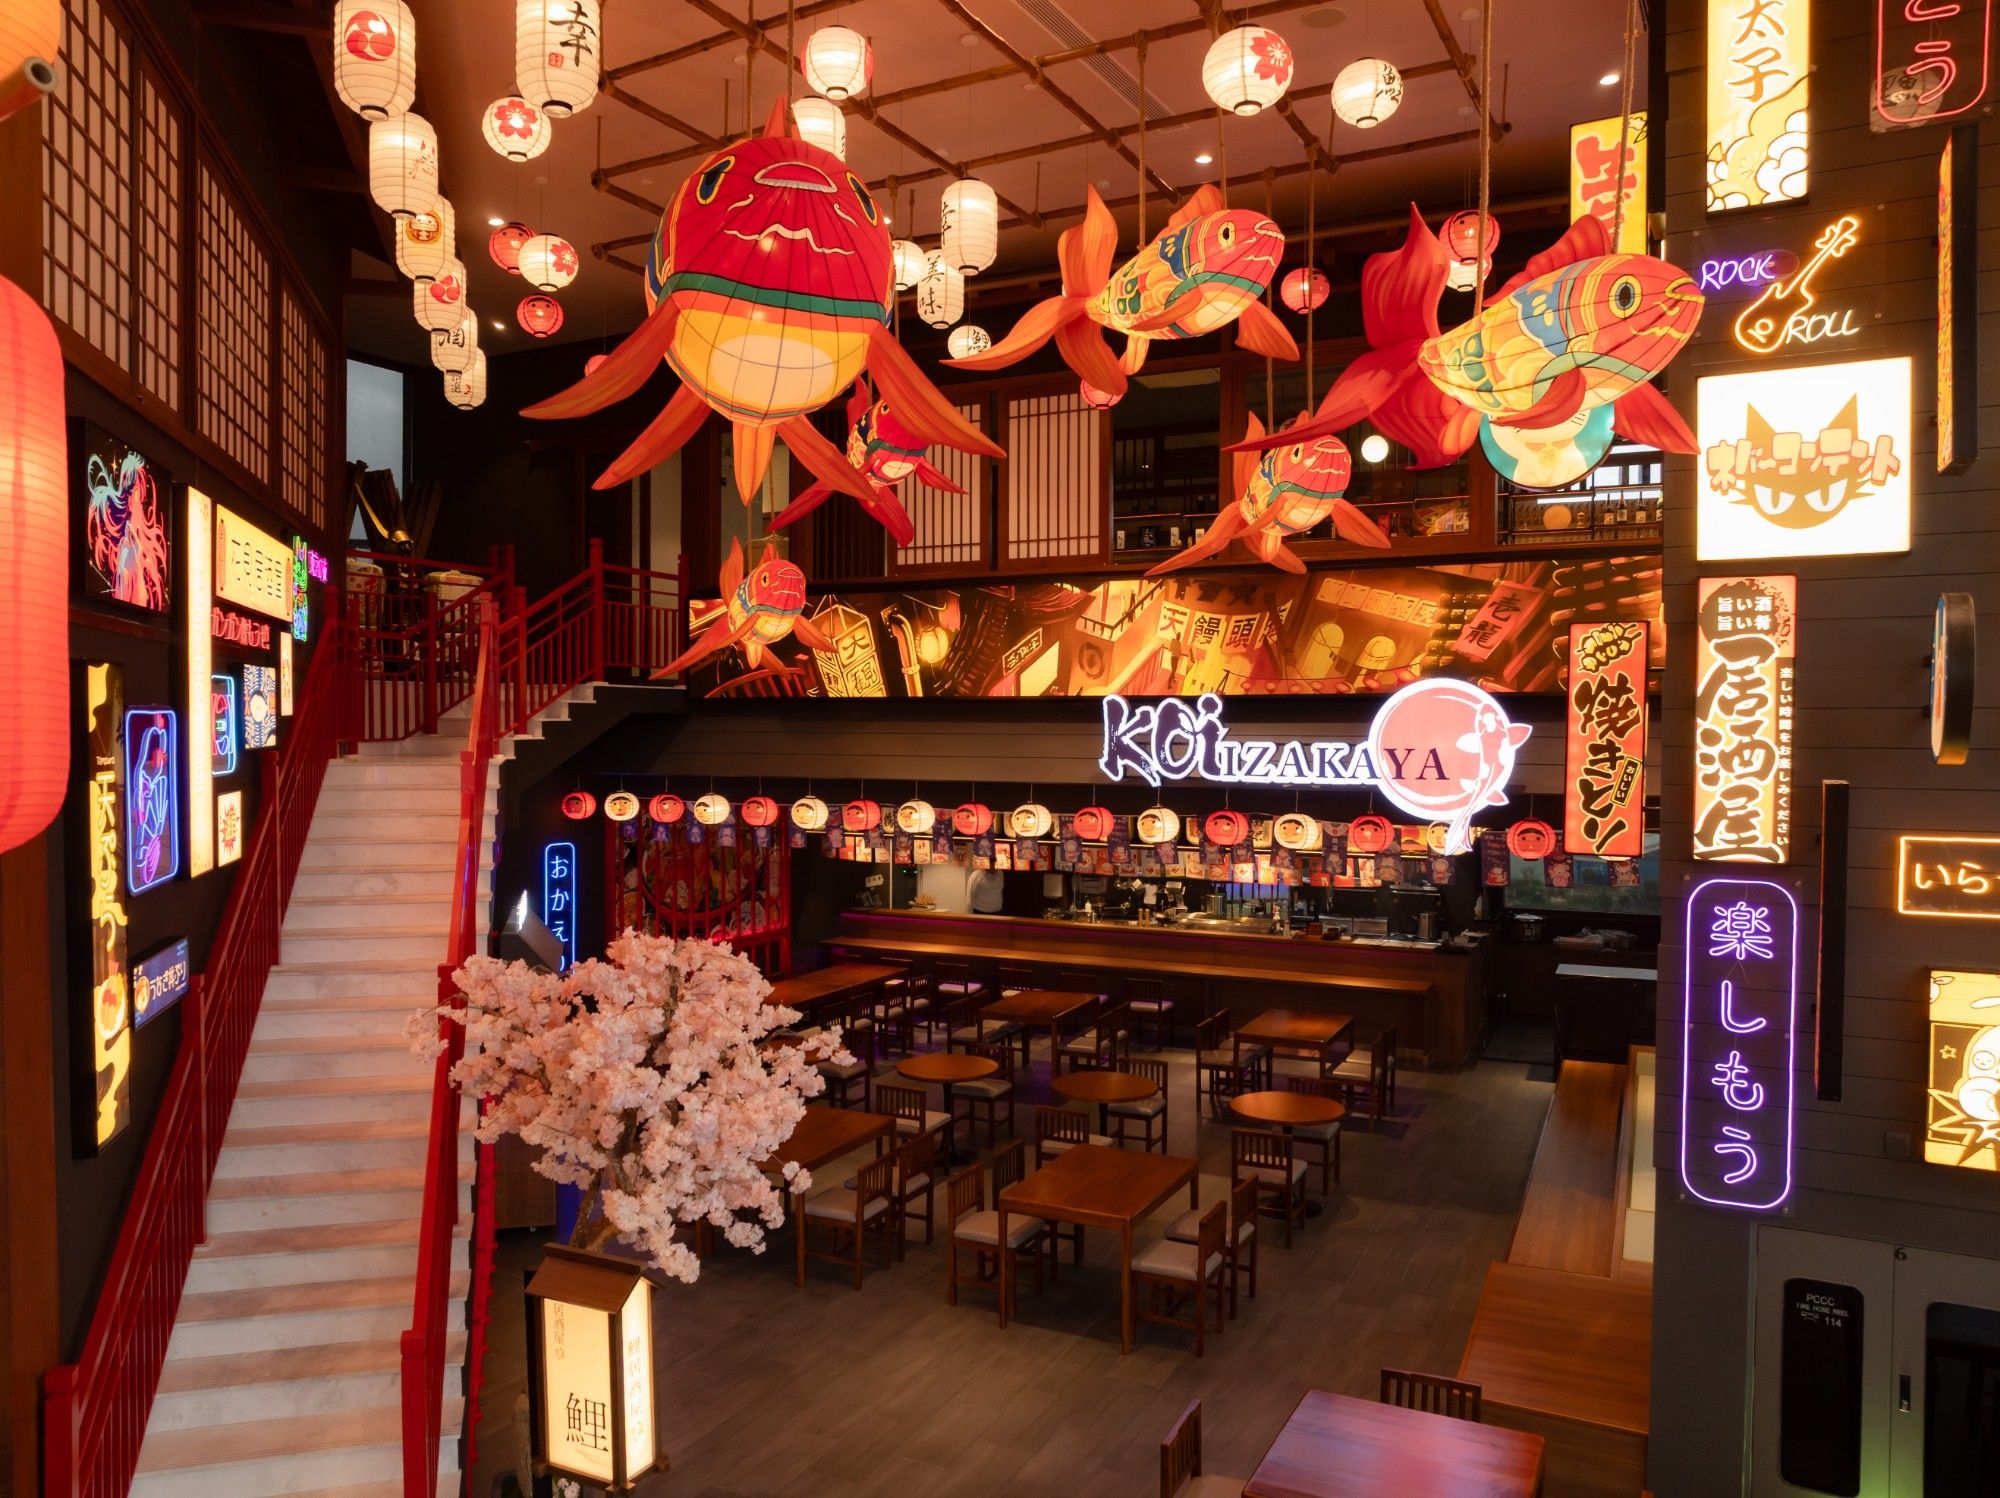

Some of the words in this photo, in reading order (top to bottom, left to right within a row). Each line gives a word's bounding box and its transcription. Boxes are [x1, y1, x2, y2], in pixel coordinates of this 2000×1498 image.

[1727, 0, 1790, 103] 太子
[921, 255, 945, 316] 美味
[1700, 253, 1776, 291] ROCK
[1785, 309, 1862, 345] ROLL
[1717, 596, 1773, 614] 旨い酒
[1717, 614, 1772, 632] 旨い肴
[1222, 744, 1450, 782] IZAKAYA
[1694, 634, 1784, 863] 居酒屋
[1615, 764, 1635, 801] おいしい
[1914, 861, 2000, 894] いら
[550, 855, 569, 972] おかえ
[1709, 900, 1774, 1185] 楽しもう
[1806, 1293, 1835, 1307] PCCC
[1825, 1316, 1842, 1327] 114
[566, 1392, 609, 1453] 鯉
